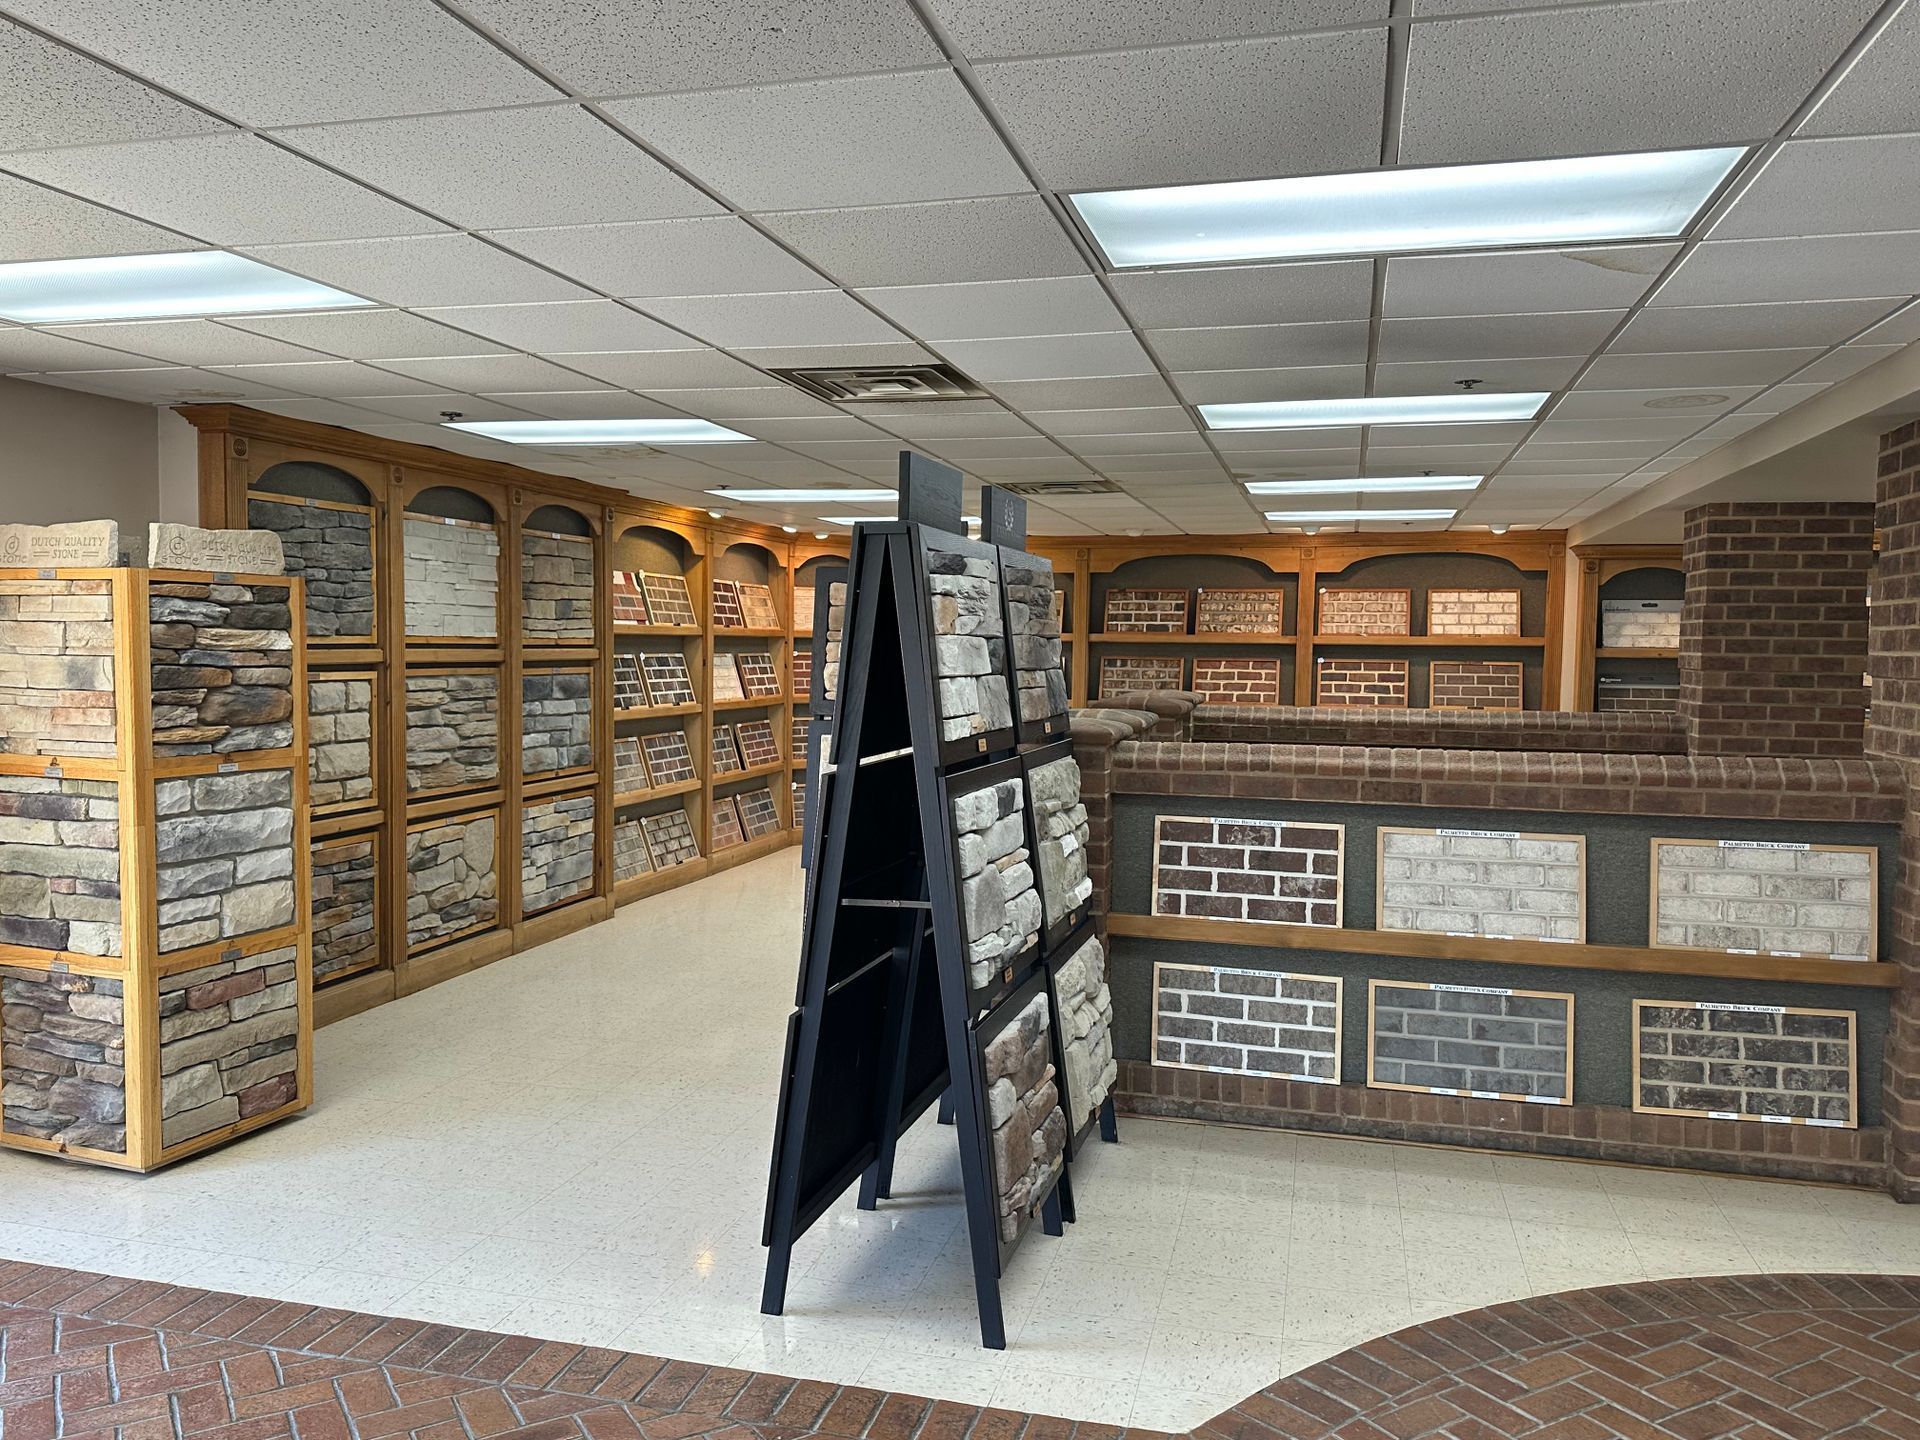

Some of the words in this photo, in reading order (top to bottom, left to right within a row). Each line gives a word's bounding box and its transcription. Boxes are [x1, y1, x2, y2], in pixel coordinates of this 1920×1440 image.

[31, 536, 60, 547] DUTCH
[64, 536, 105, 547] QUALITY
[202, 540, 233, 552] DUTCH
[237, 543, 278, 556] QUALITY
[52, 549, 80, 559] STONE
[228, 554, 258, 565] STONE
